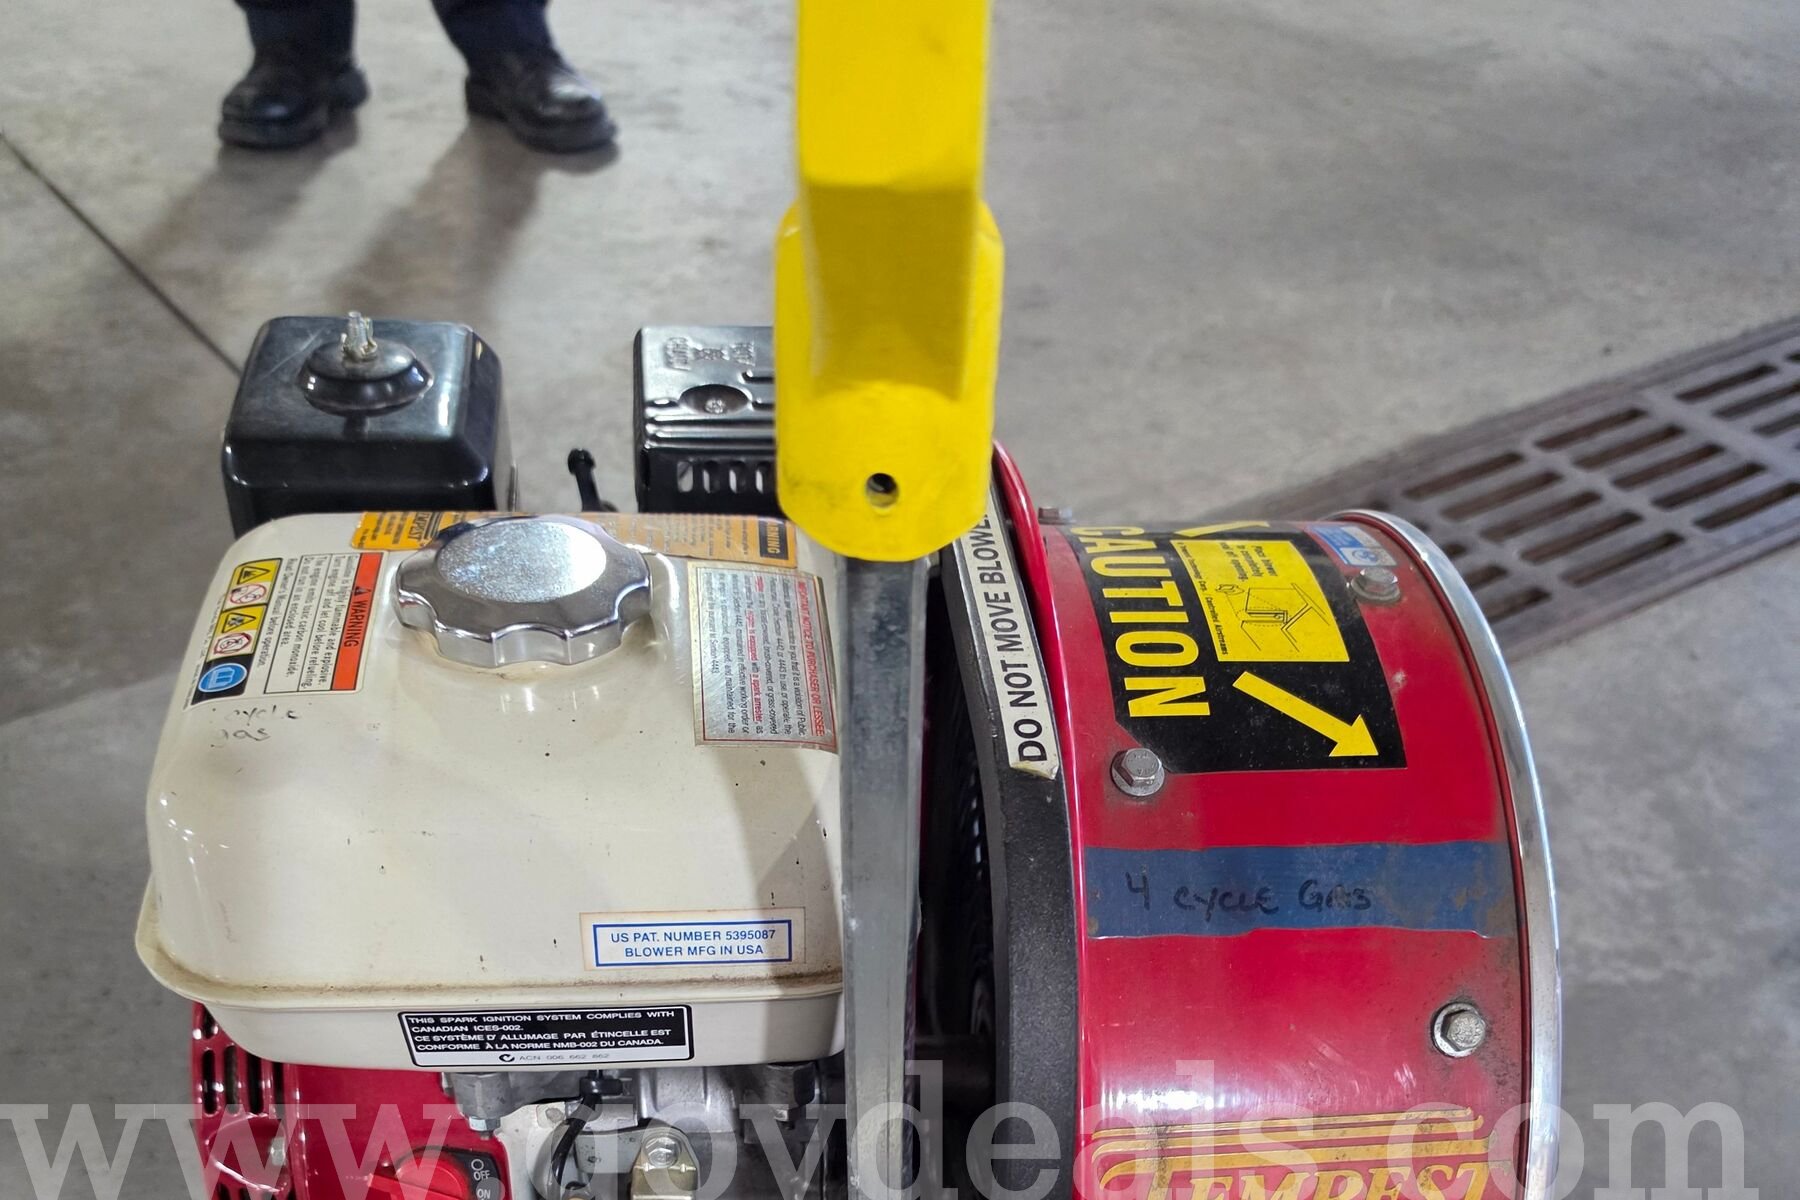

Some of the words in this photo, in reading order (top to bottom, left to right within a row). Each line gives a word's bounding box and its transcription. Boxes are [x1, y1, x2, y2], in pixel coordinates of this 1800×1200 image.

[767, 520, 781, 553] ARNING
[968, 514, 1006, 584] BLOWE
[284, 602, 300, 629] enclosed
[316, 619, 328, 632] cool
[343, 600, 367, 647] WARNING
[984, 591, 1024, 652] MOVE
[1070, 526, 1210, 717] CAUTION
[294, 620, 310, 642] carbon
[310, 634, 325, 654] before
[325, 637, 338, 649] and
[284, 643, 305, 677] monoxide.
[314, 651, 335, 685] explosive.
[300, 656, 320, 689] refueling.
[806, 650, 819, 691] PURCHASER
[1000, 660, 1037, 708] NOT
[811, 693, 821, 704] OR
[740, 709, 749, 726] order
[764, 692, 778, 734] grass-covered
[727, 722, 737, 734] the
[783, 724, 793, 735] the
[797, 717, 807, 735] Public
[1013, 719, 1047, 762] DO
[1125, 872, 1150, 911] 4
[611, 932, 629, 943] US
[633, 932, 660, 942] PAT.
[664, 930, 721, 942] NUMBER
[726, 929, 776, 940] 5395087
[625, 946, 683, 957] BLOWER
[687, 946, 716, 956] MFG
[720, 945, 732, 955] IN
[737, 944, 763, 954] USA
[586, 1012, 642, 1020] COMPLIES
[433, 1033, 484, 1041] SYSTÈME
[500, 1032, 559, 1041] ALLUMAGE
[591, 1029, 649, 1039] ÉTINCELLE
[473, 1024, 524, 1032] ICES-002.
[417, 1043, 480, 1051] CONFORME
[485, 1042, 493, 1050] À
[511, 1042, 551, 1050] NORME
[553, 1041, 598, 1049] NMB-002
[473, 1170, 490, 1181] OFF
[477, 1188, 490, 1200] ON
